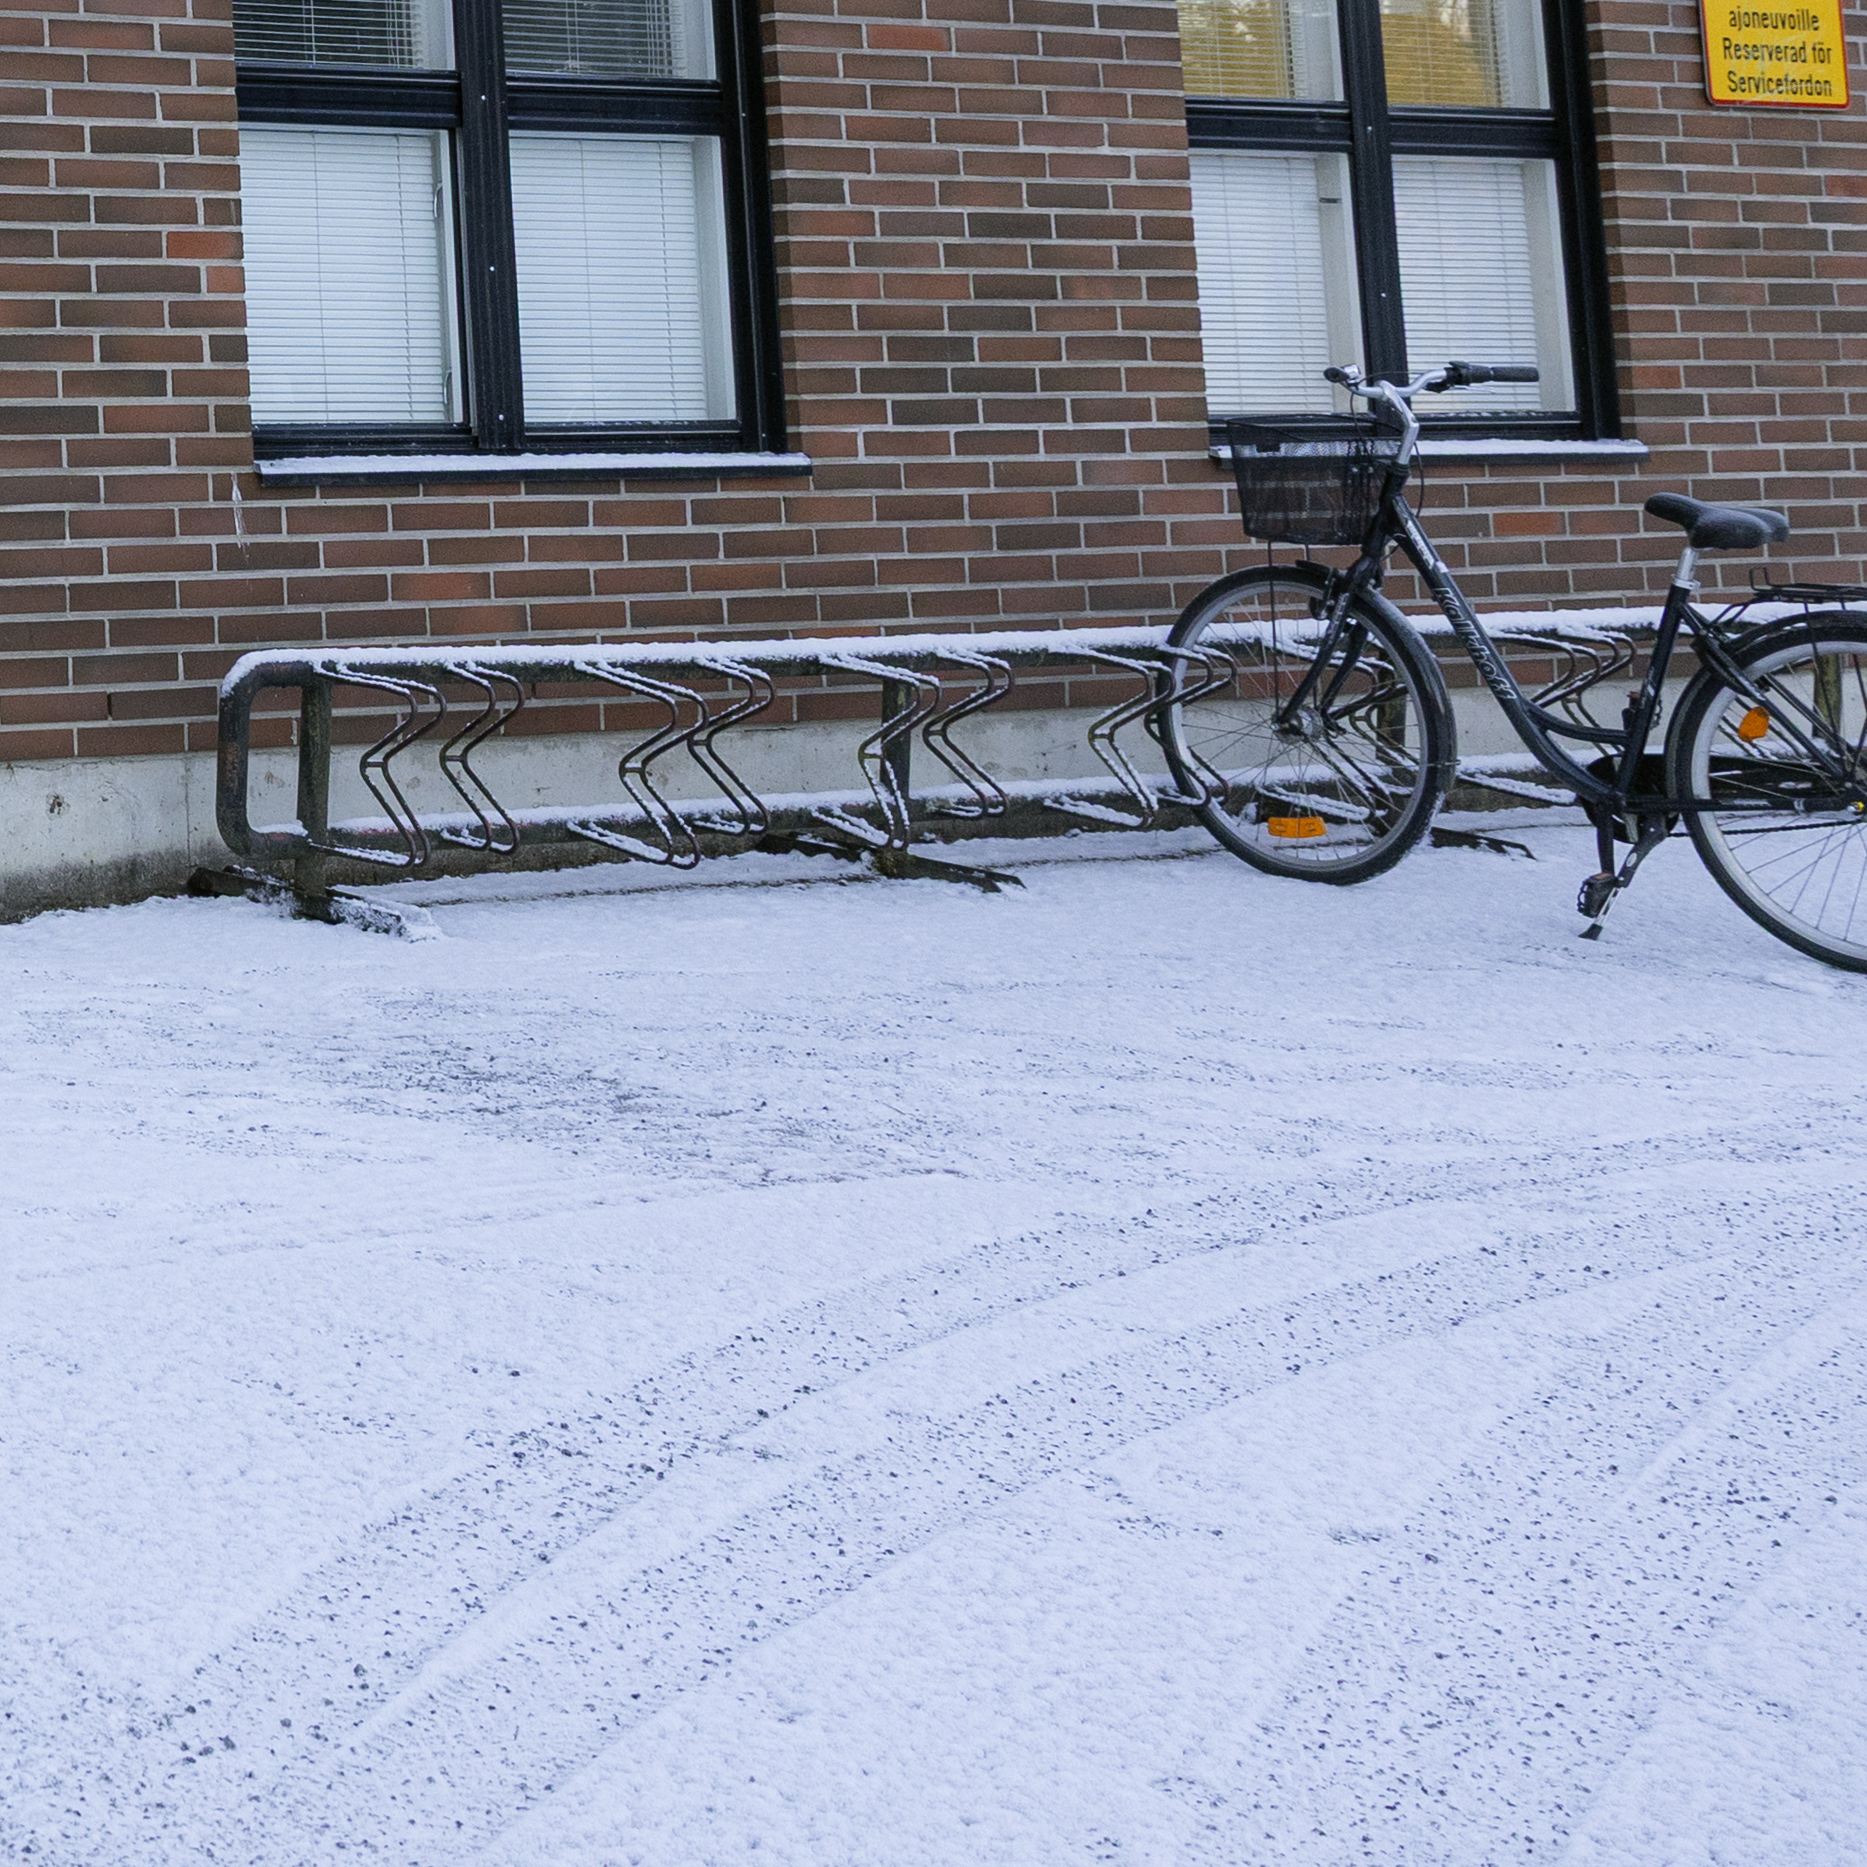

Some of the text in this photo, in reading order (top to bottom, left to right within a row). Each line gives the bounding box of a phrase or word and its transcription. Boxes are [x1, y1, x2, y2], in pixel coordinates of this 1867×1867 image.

[1729, 5, 1820, 31] ajoneuvoille
[1722, 37, 1832, 64] Reserverad för
[1727, 70, 1833, 96] Servicefordon
[1435, 587, 1517, 700] Kalkhoff
